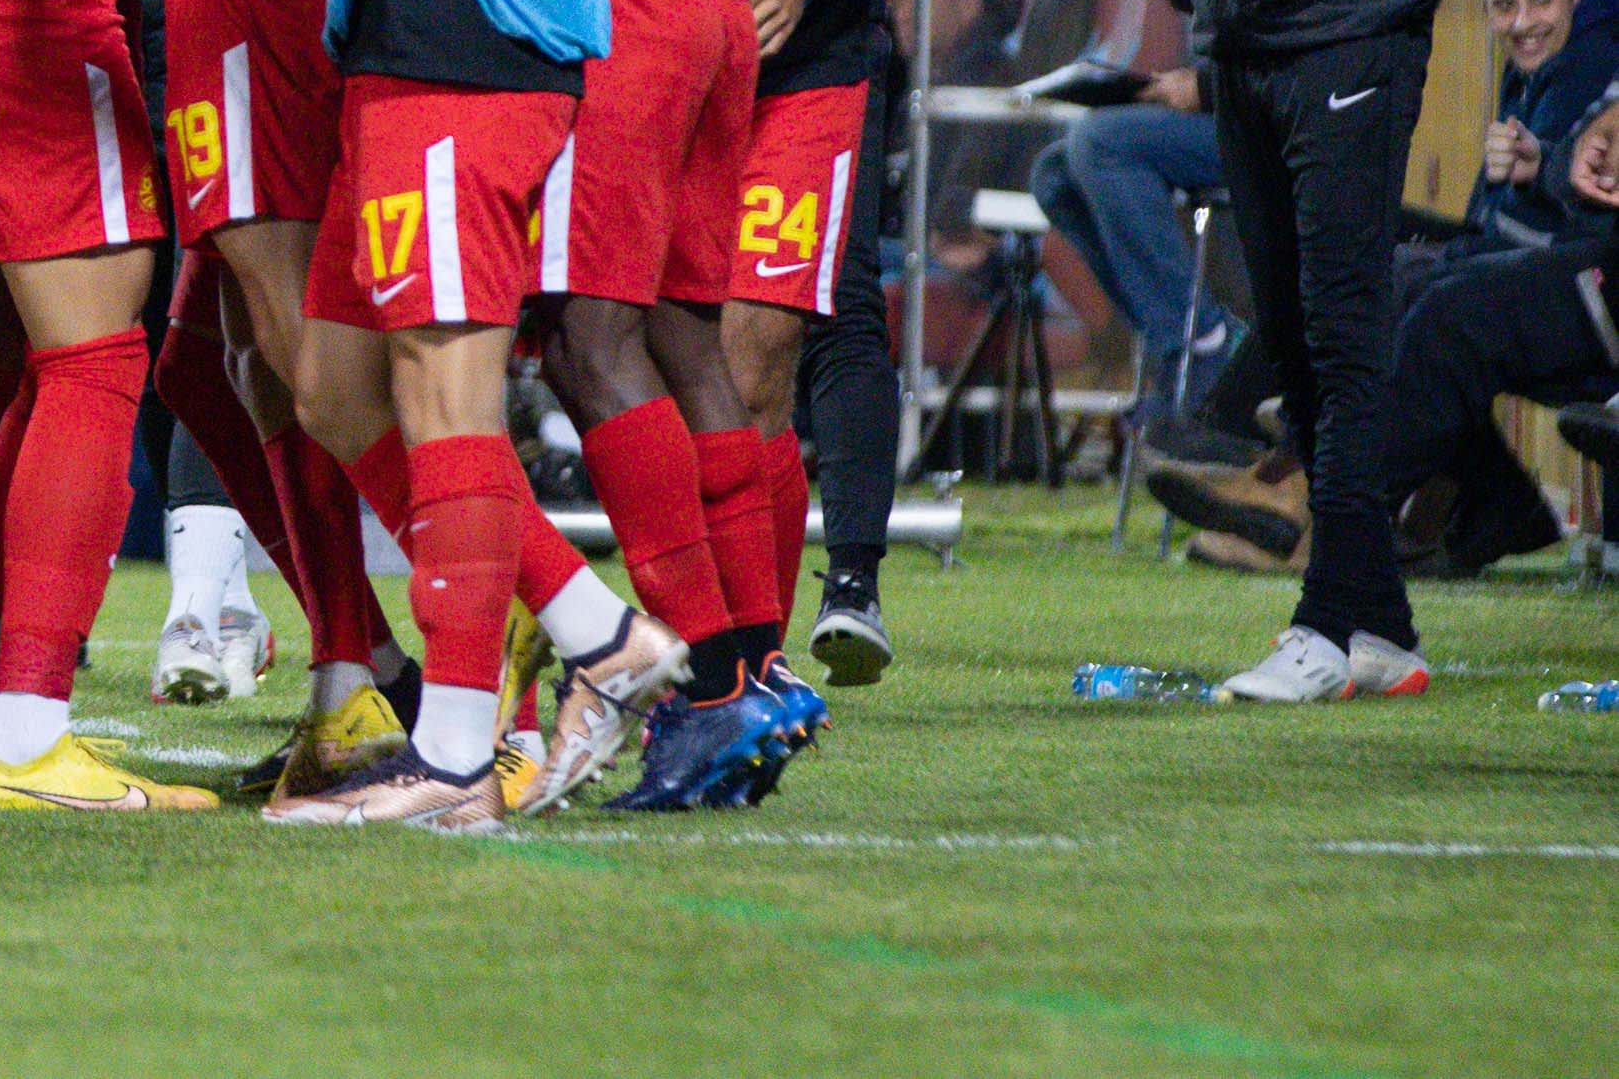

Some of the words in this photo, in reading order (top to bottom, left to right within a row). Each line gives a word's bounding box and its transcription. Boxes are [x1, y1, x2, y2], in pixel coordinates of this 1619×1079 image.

[167, 100, 222, 182] 19
[361, 189, 422, 279] 17
[739, 184, 818, 259] 24
